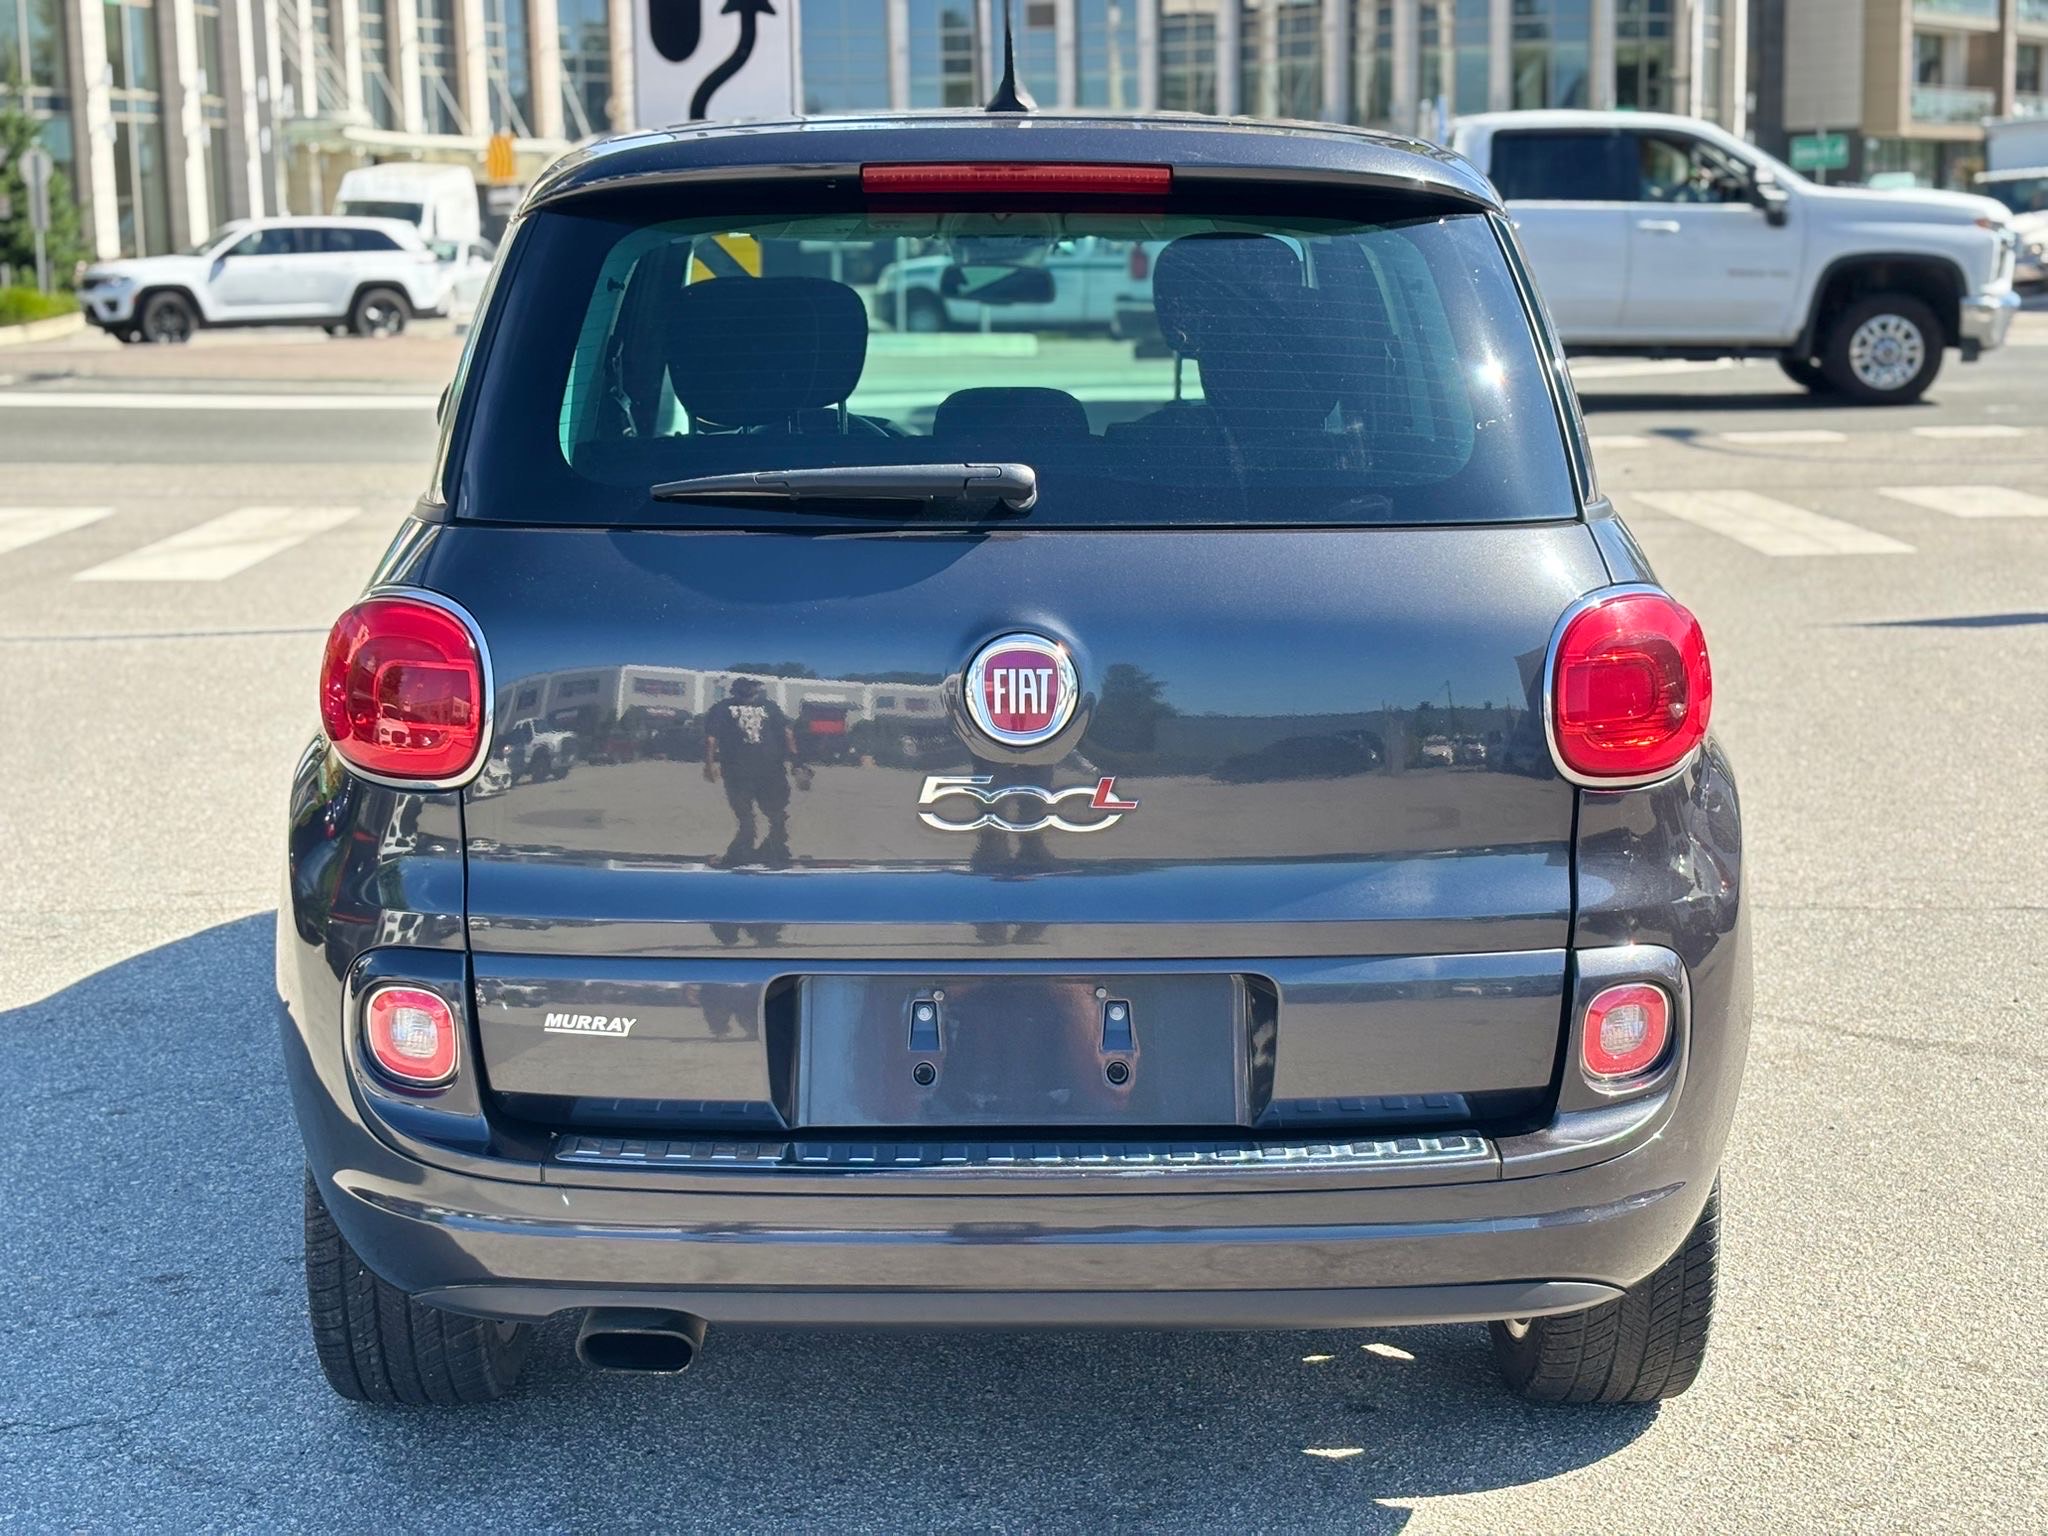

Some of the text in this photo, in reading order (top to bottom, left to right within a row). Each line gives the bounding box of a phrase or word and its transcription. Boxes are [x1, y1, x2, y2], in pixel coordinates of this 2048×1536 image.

[993, 668, 1053, 715] FIAT
[918, 775, 1139, 832] 500L
[543, 1012, 637, 1037] MURRAY
